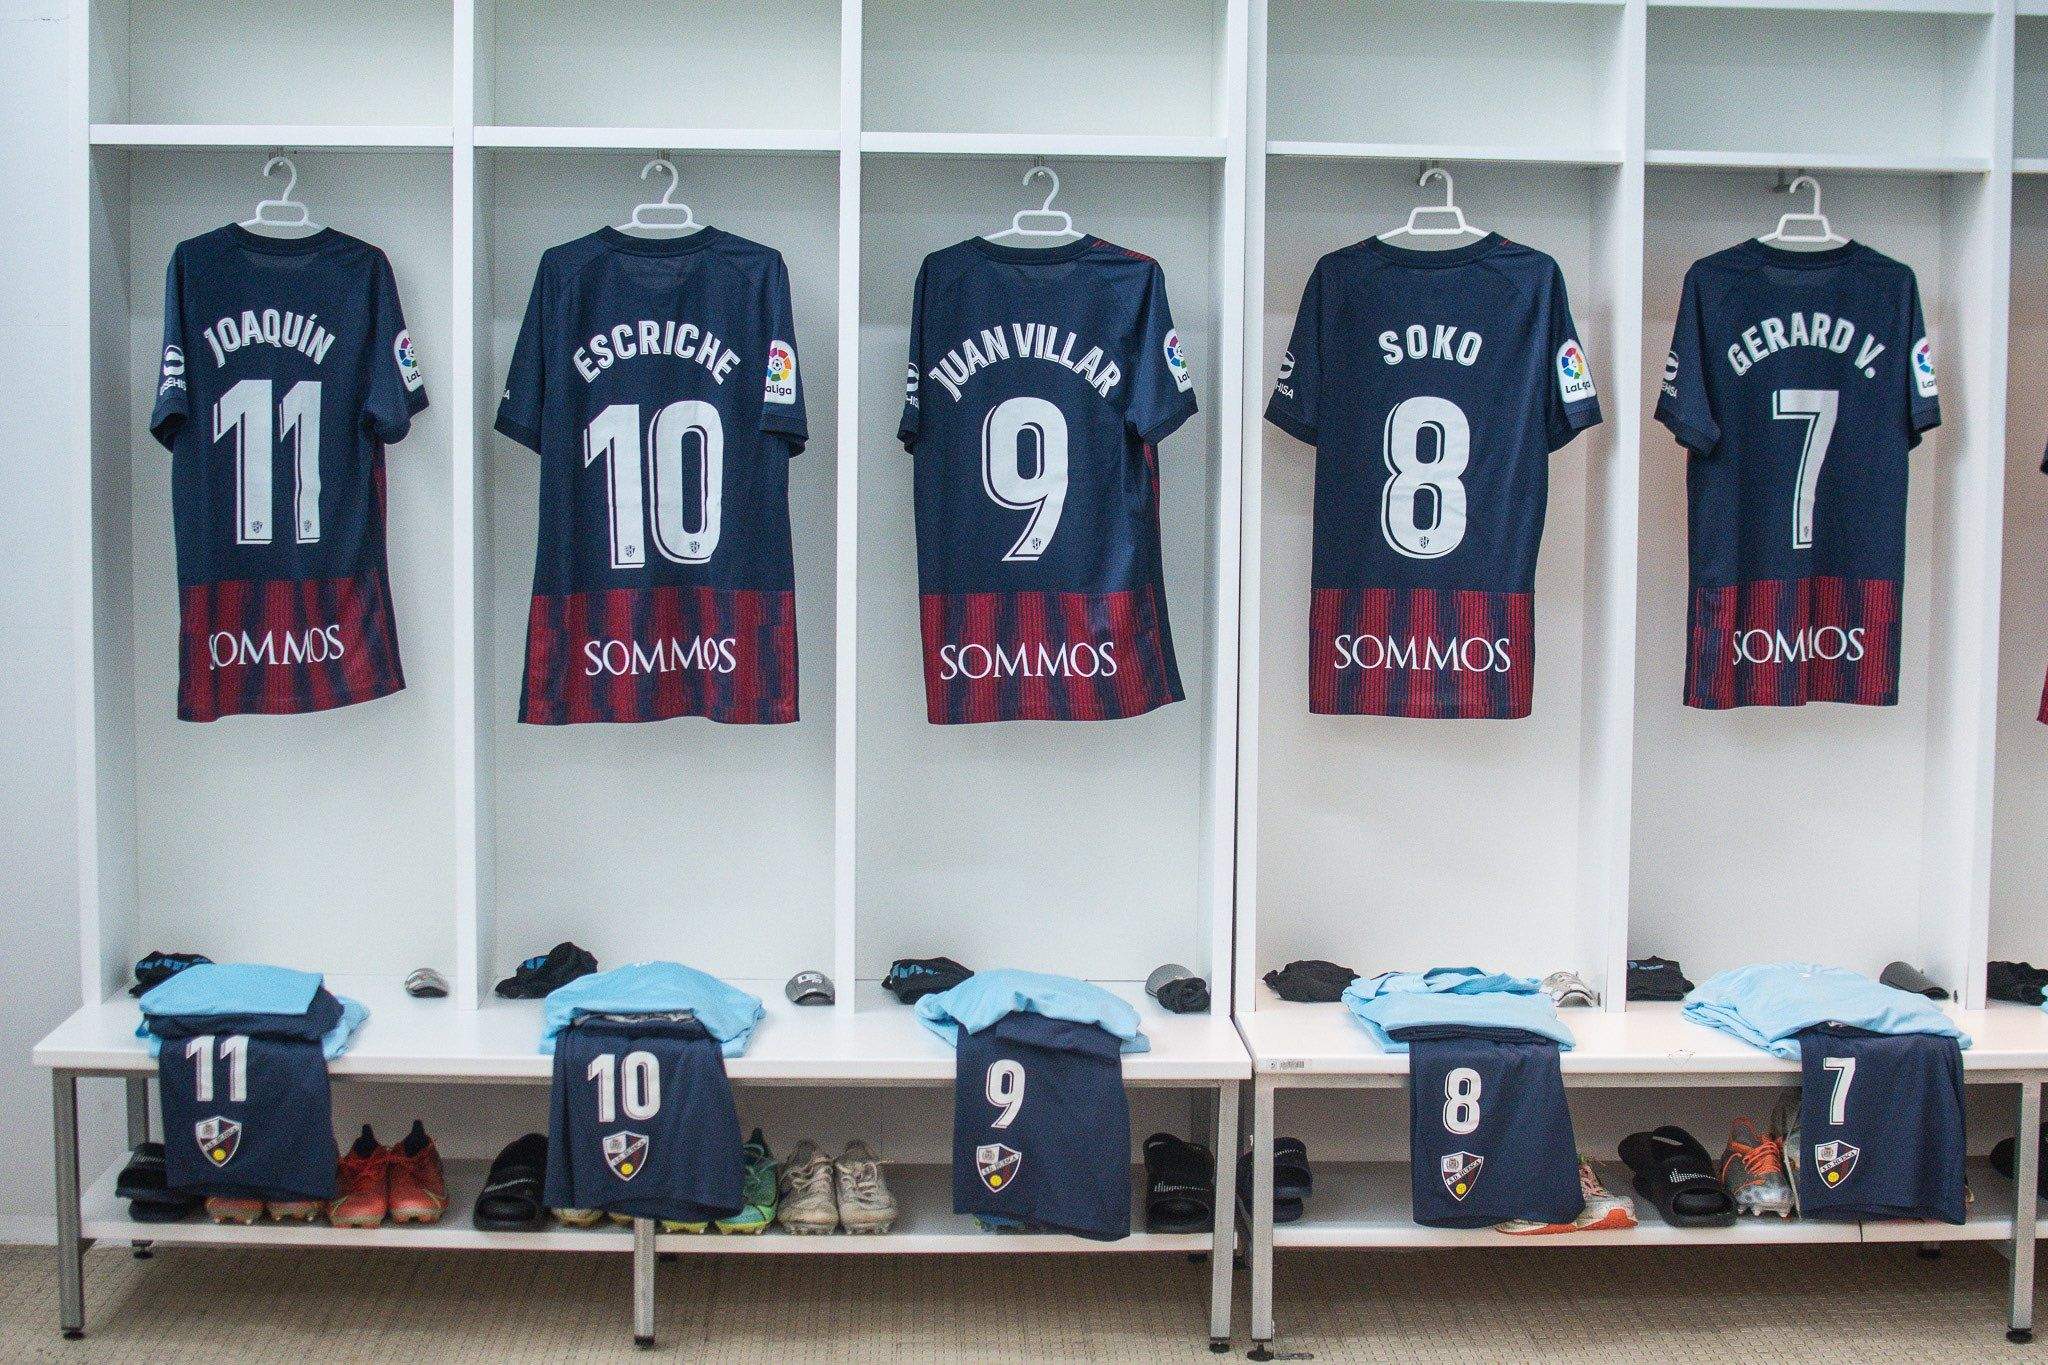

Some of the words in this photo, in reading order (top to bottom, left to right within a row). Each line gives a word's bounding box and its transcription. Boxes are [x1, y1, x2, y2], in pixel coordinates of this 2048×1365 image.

[204, 309, 336, 367] JOAQUÍN
[573, 320, 740, 385] ESCRICHE
[928, 325, 1013, 410] JUAN
[1012, 322, 1122, 403] VILLAR
[1379, 324, 1482, 366] SOKO
[1727, 312, 1854, 376] GERARD
[1851, 333, 1885, 379] V.
[765, 384, 792, 396] aLiga
[213, 379, 322, 545] 11
[583, 400, 724, 570] 10
[981, 396, 1069, 562] 9
[1380, 395, 1471, 560] 8
[1772, 389, 1839, 550] 7
[584, 636, 737, 676] SOMMOS
[940, 641, 1118, 680] SOMMOS
[1334, 634, 1511, 673] SOMMOS
[180, 1035, 248, 1101] 11
[587, 1050, 661, 1123] 10
[985, 1059, 1026, 1129] 9
[1442, 1067, 1482, 1135] 8
[1822, 1056, 1856, 1126] 7
